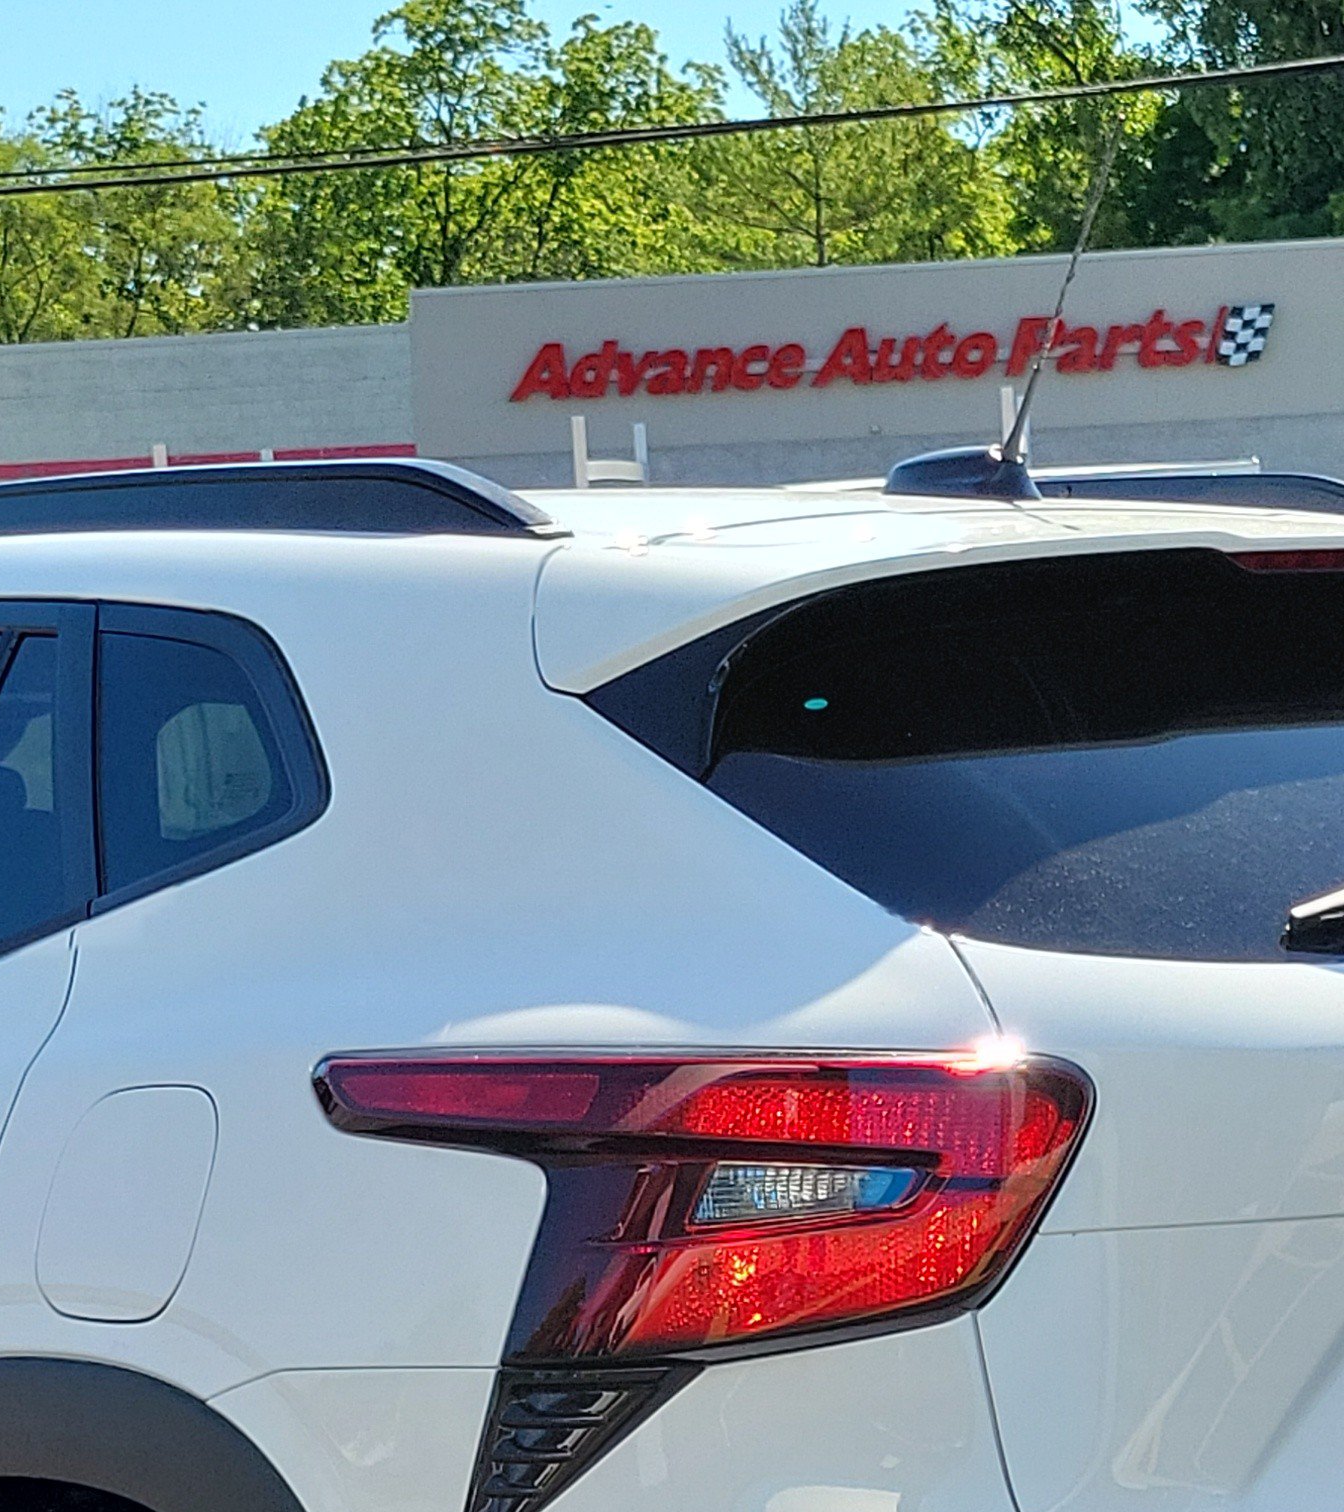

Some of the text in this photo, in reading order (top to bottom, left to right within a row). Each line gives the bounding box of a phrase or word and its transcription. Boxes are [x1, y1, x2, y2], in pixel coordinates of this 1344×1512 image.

[510, 308, 1205, 402] Advance Auto Parts
